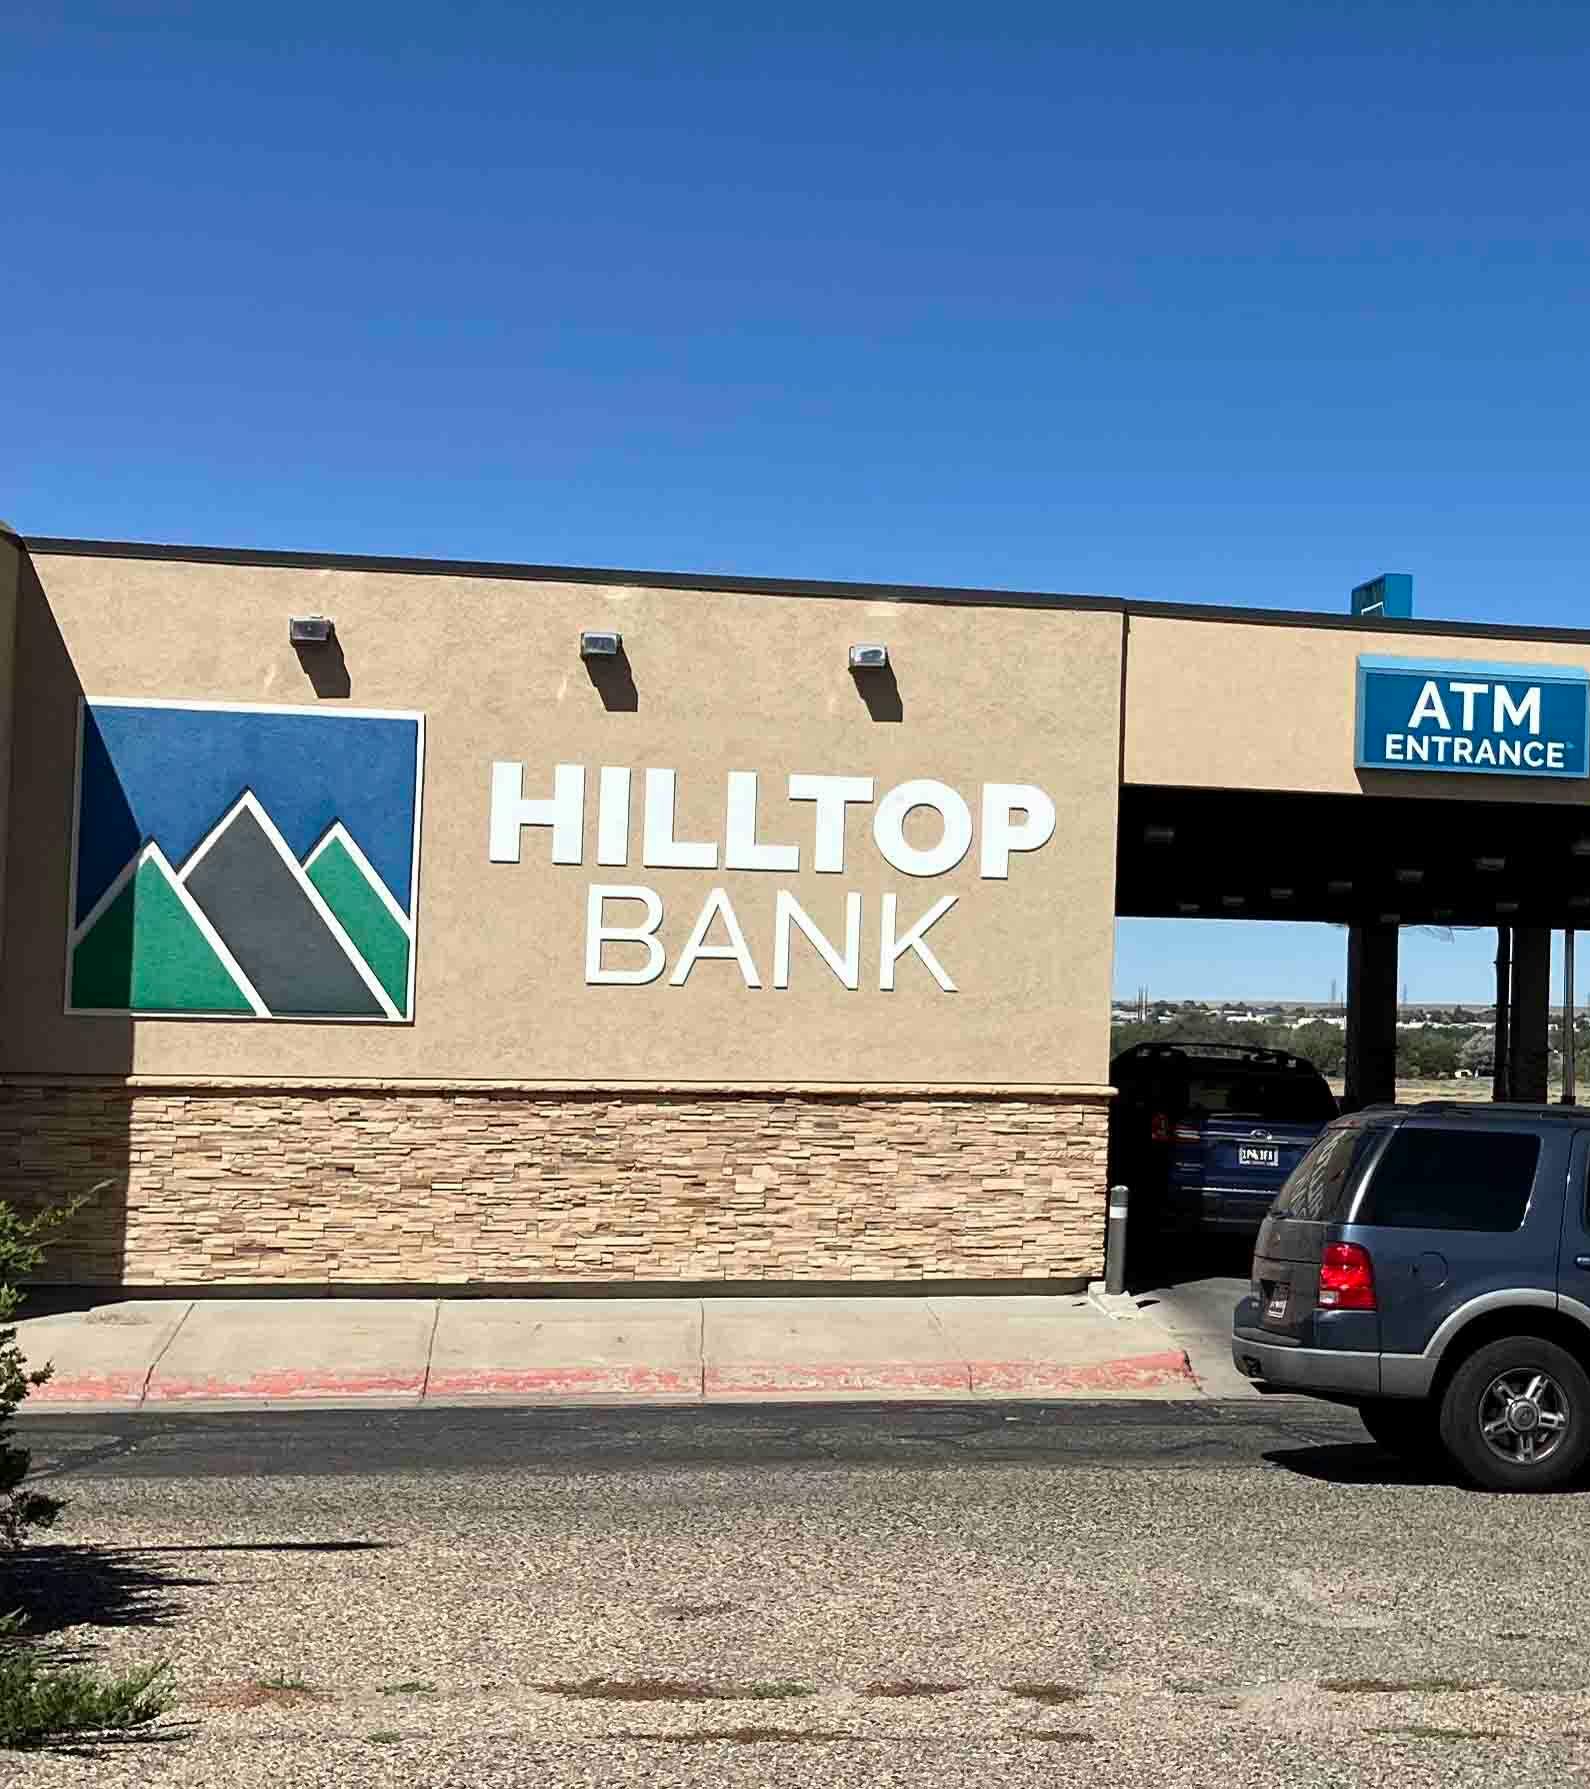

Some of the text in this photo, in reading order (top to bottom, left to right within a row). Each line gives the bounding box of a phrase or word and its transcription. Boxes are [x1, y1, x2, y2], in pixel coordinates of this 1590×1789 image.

[1407, 681, 1541, 734] ATM
[1385, 734, 1565, 768] ENTRANCE
[489, 761, 1056, 878] HILLTOP
[585, 883, 960, 991] BANK
